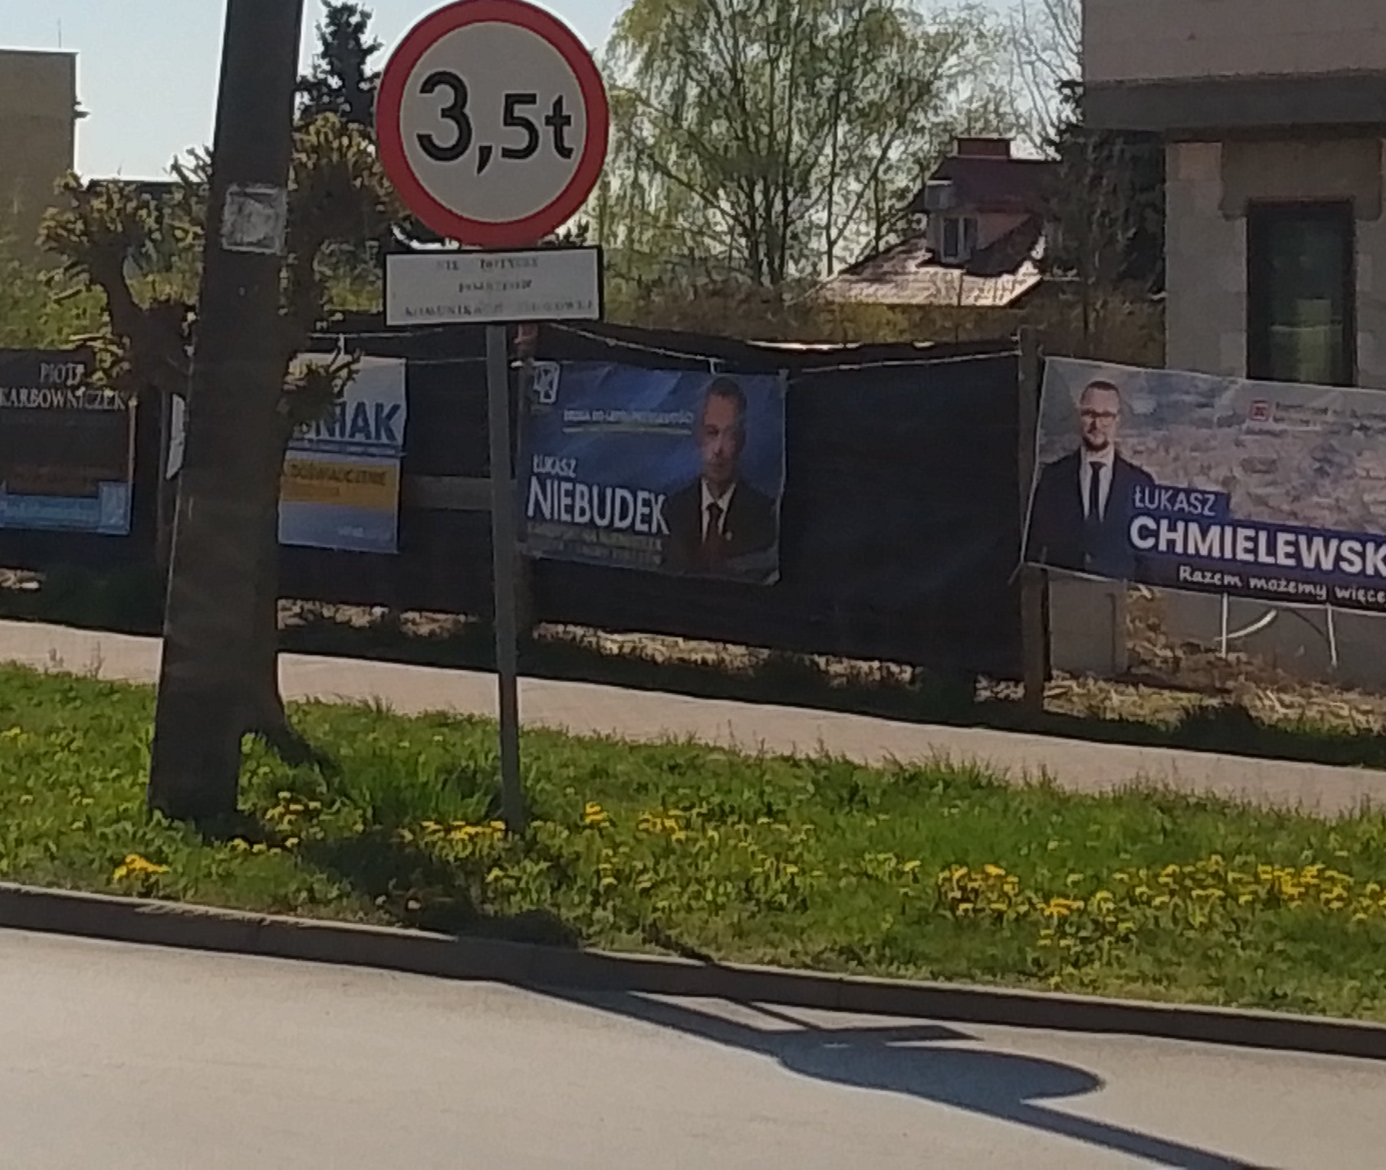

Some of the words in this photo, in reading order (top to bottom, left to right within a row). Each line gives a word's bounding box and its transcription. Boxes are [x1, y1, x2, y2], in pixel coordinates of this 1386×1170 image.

[416, 70, 575, 175] 3,5t
[299, 401, 401, 442] NIAK
[526, 475, 671, 536] NIEBUDEK
[1133, 485, 1217, 517] ŁUKASZ
[1178, 565, 1243, 588] Razem
[1247, 576, 1328, 601] możemy
